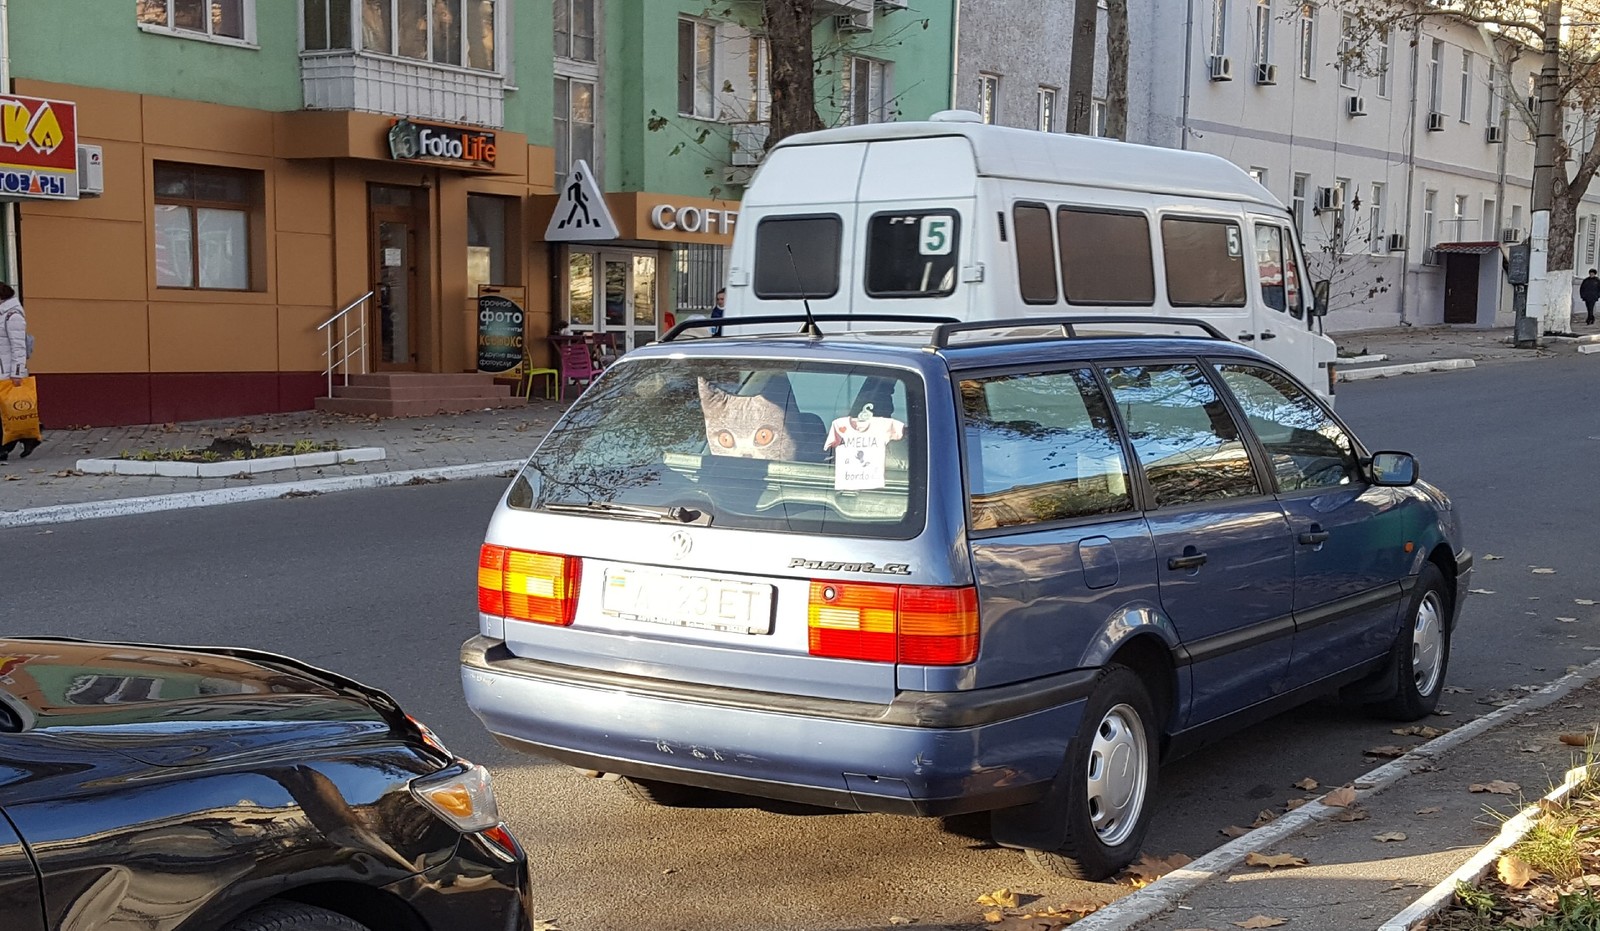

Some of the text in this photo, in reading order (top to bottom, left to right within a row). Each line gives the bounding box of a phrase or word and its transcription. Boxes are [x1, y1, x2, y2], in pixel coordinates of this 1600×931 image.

[926, 222, 945, 251] 5
[1229, 228, 1238, 253] 5
[480, 300, 512, 308] срочное
[480, 307, 523, 325] фото
[840, 436, 878, 448] AMELIA
[845, 471, 870, 481] bordo
